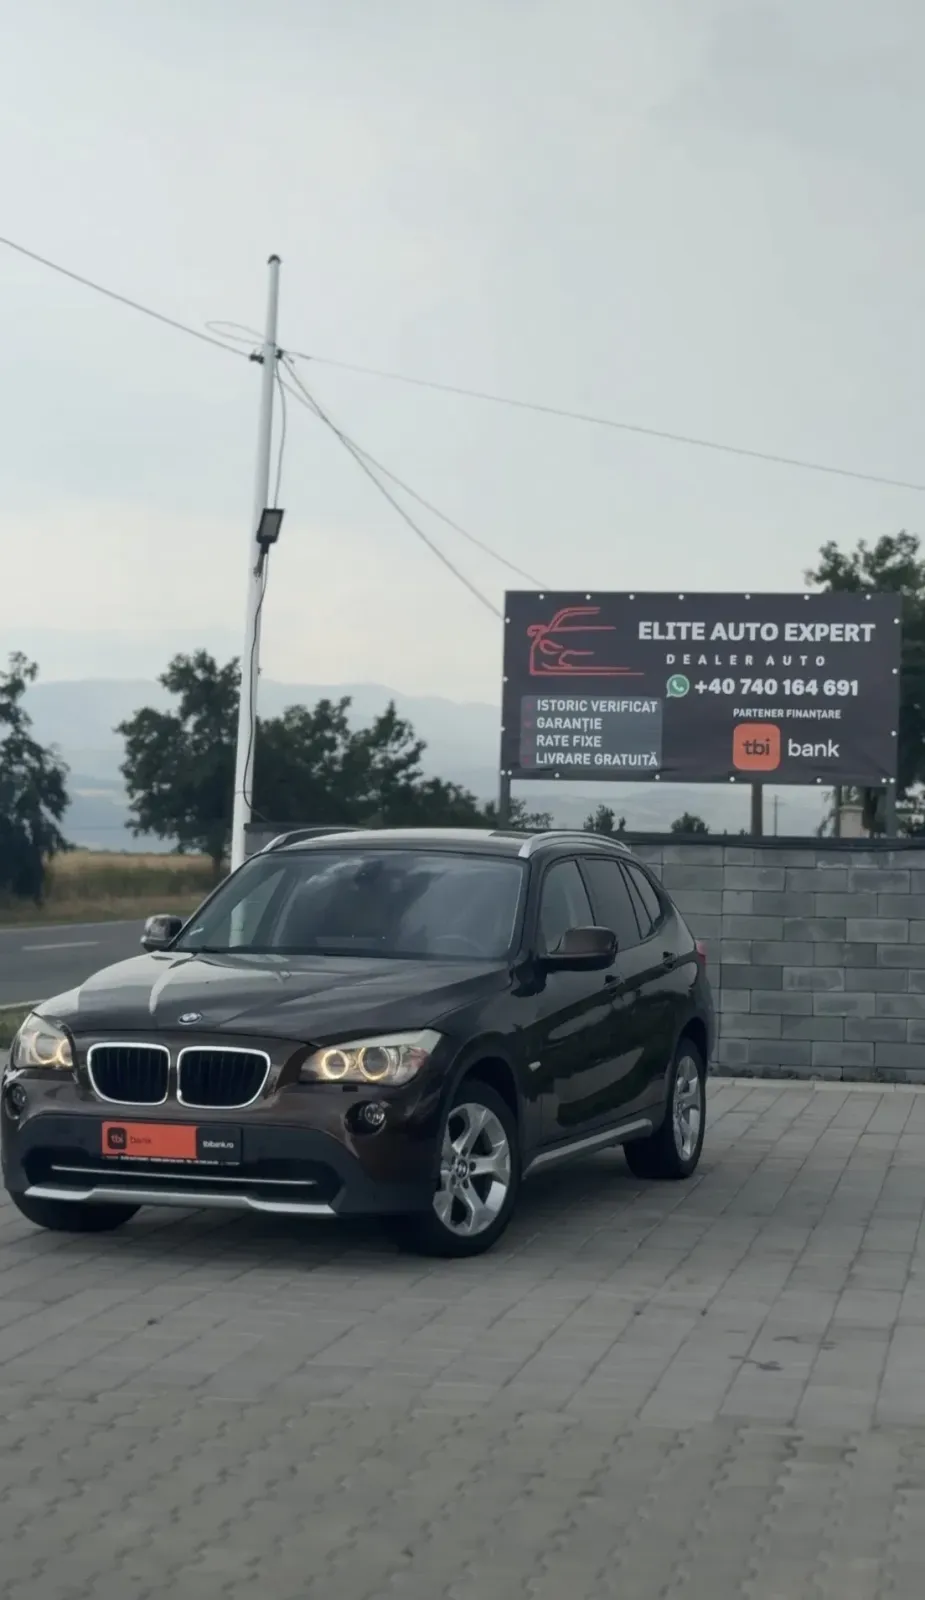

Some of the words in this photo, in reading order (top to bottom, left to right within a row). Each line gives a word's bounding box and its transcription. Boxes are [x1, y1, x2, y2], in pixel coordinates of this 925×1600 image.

[638, 621, 706, 641] ELITE
[710, 622, 779, 642] AUTO
[784, 623, 876, 643] EXPERT
[666, 654, 753, 666] DEALER
[765, 655, 826, 667] AUTO
[694, 678, 735, 695] +40
[740, 678, 778, 695] 740
[783, 679, 819, 696] 164
[823, 680, 859, 696] 691
[536, 699, 588, 712] ISTORIC
[591, 700, 658, 713] VERIFICAT
[733, 708, 784, 718] PARTENER
[536, 735, 569, 747] RATE
[573, 736, 602, 747] FIXE
[743, 738, 771, 755] tbi
[788, 738, 840, 758] bank
[535, 753, 591, 765] LIVRARE
[594, 752, 659, 766] GRATUITĂ
